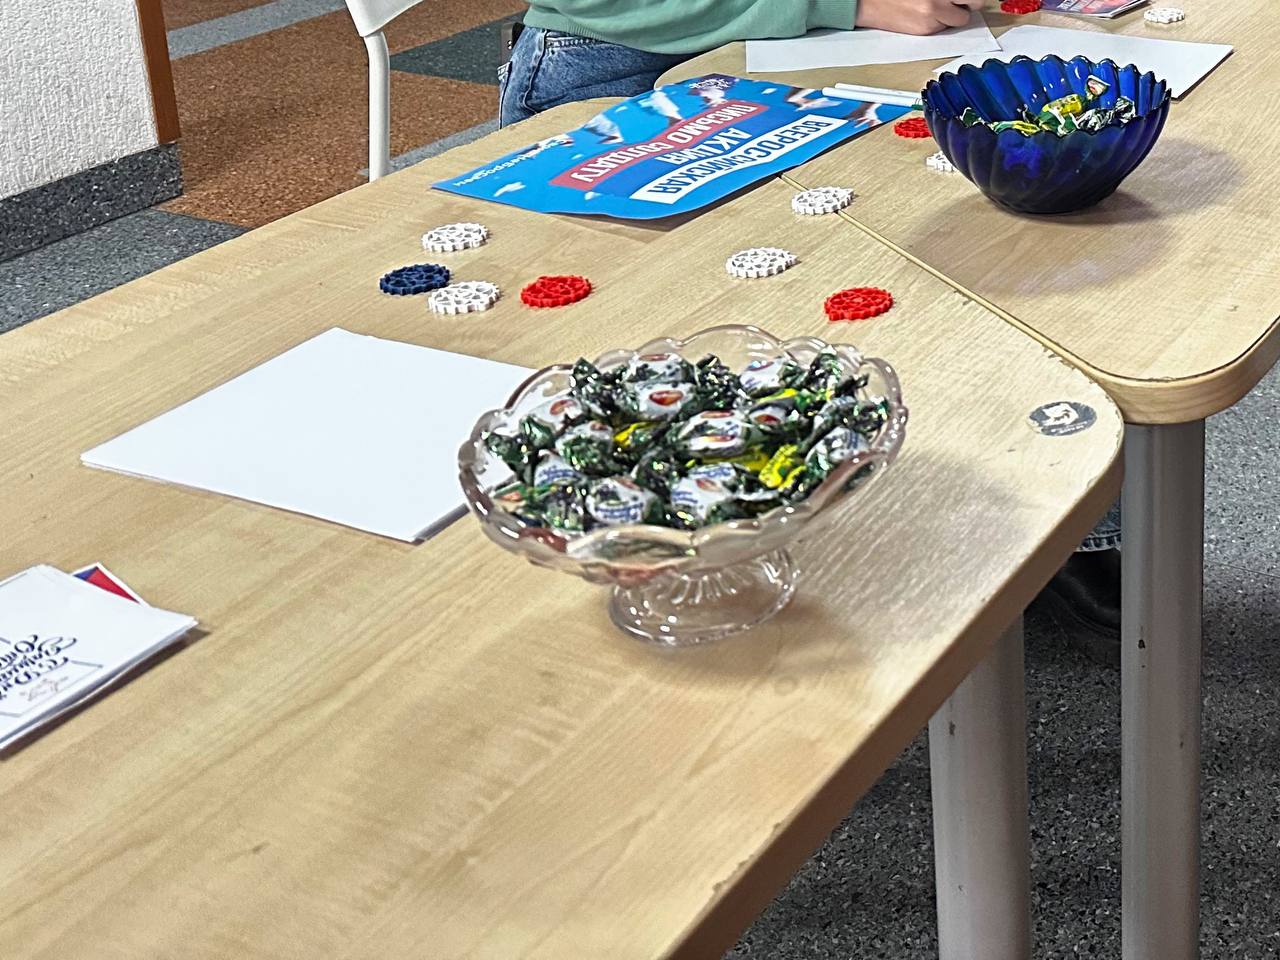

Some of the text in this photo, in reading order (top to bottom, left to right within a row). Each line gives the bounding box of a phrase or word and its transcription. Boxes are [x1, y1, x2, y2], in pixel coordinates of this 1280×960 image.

[570, 103, 758, 183] ПИСЬМО СОЛДАТУ
[647, 120, 834, 194] ВСЕРОССИЙСКАЯ
[655, 127, 752, 164] АКЦИЯ
